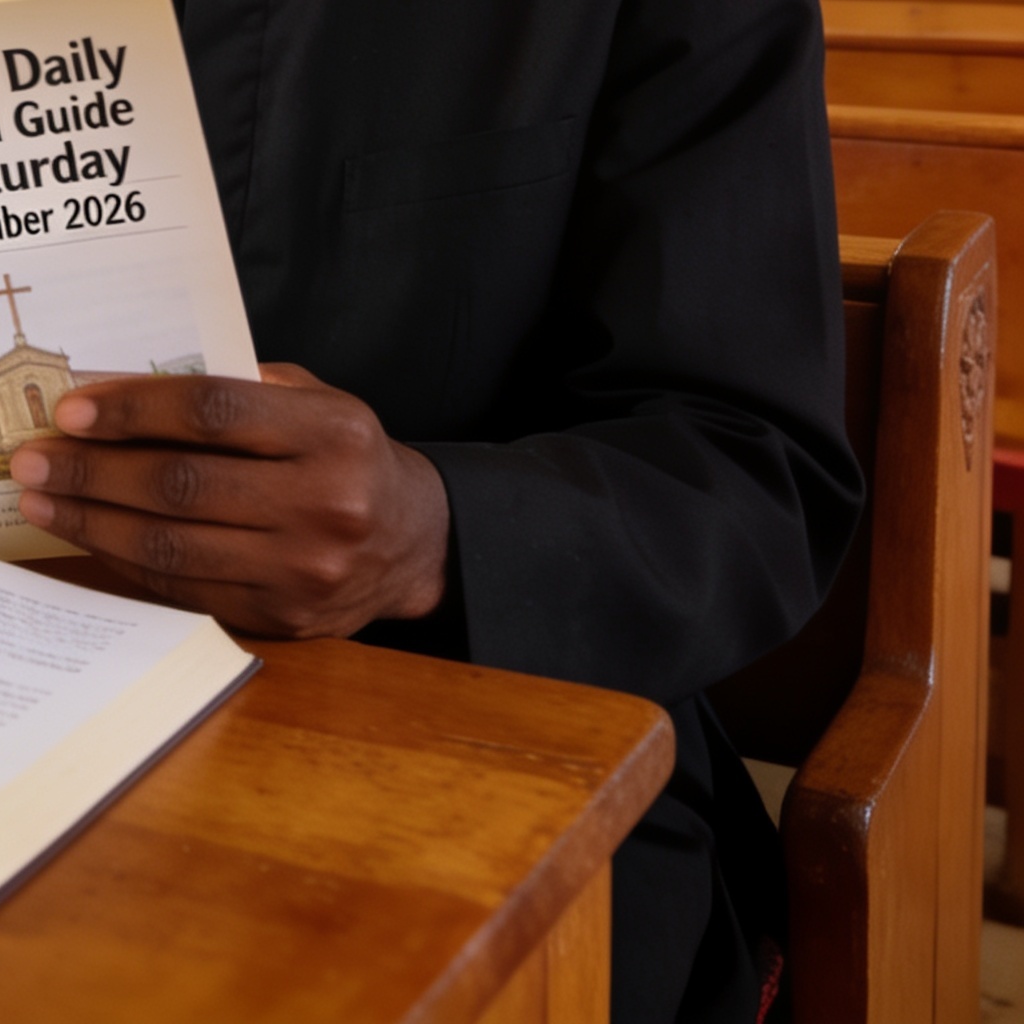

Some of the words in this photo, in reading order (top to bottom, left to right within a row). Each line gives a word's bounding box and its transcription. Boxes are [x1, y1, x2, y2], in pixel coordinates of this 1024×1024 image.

[2, 36, 127, 92] Daily
[13, 90, 135, 138] Guide
[63, 190, 146, 230] 2026
